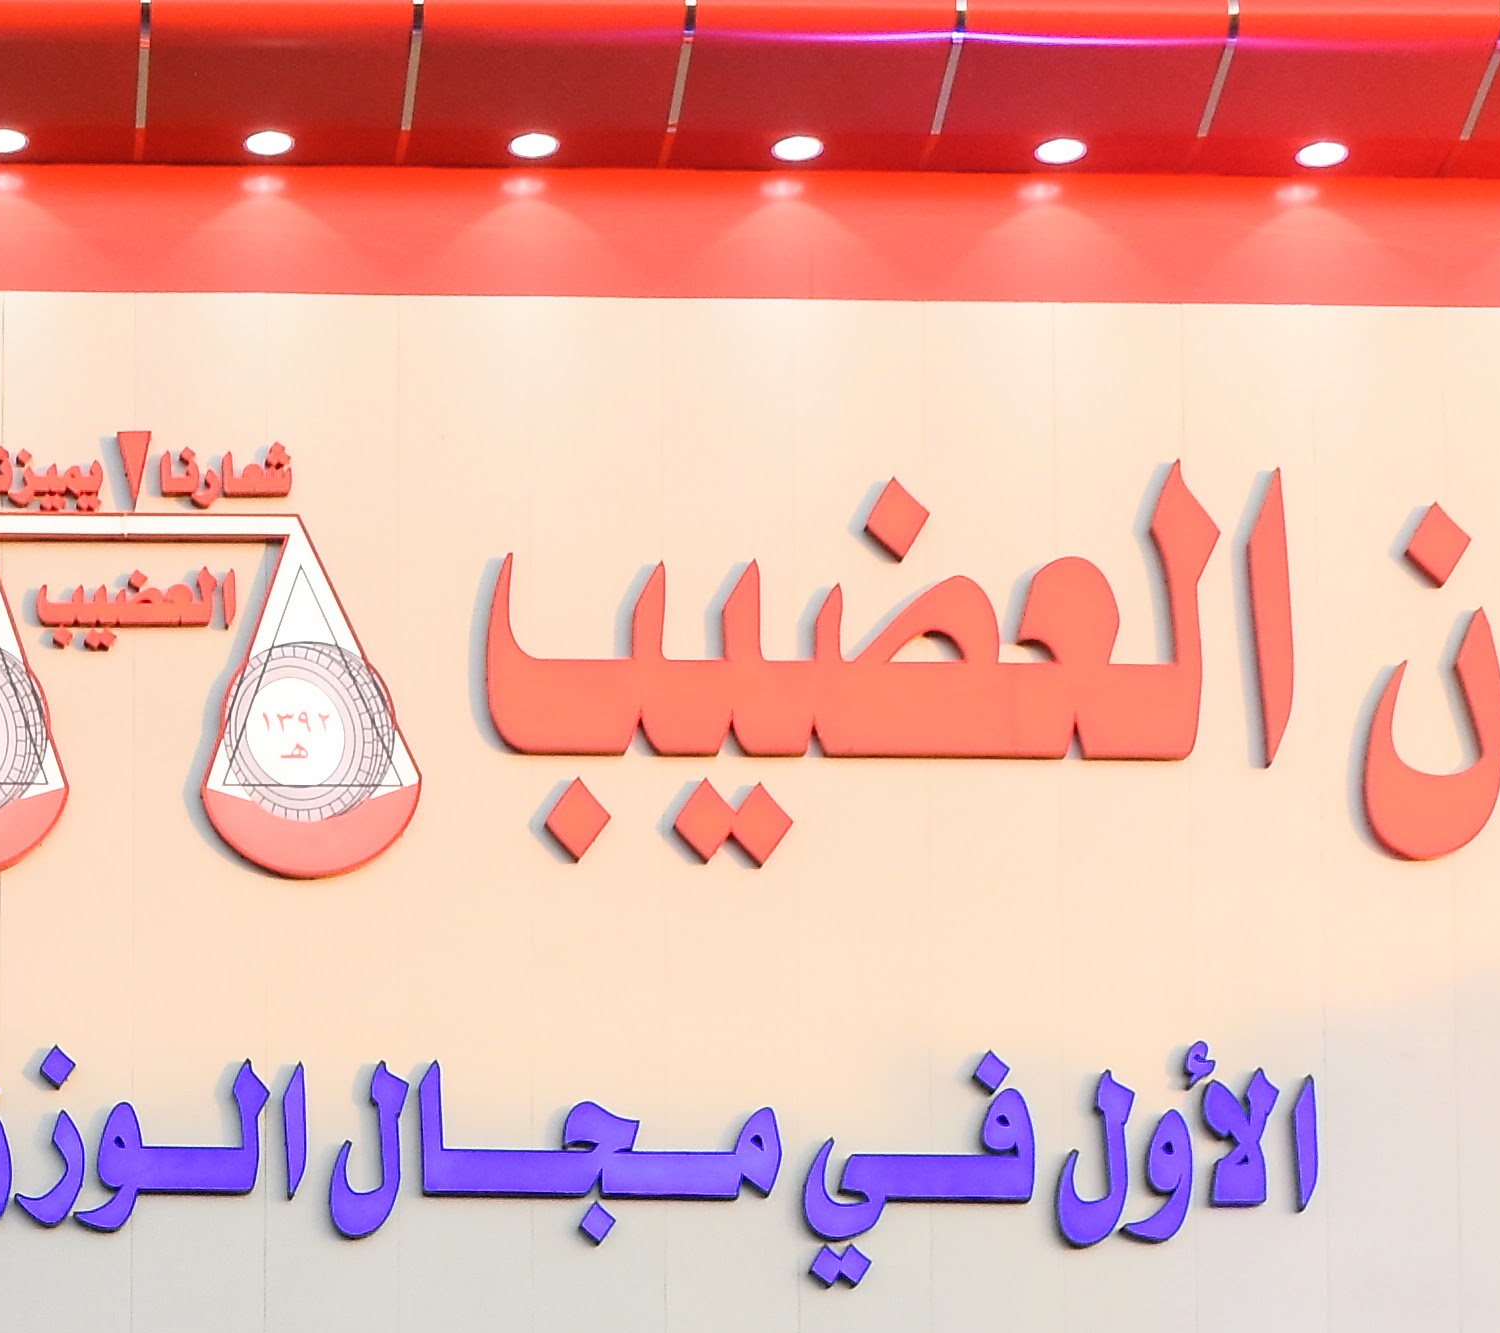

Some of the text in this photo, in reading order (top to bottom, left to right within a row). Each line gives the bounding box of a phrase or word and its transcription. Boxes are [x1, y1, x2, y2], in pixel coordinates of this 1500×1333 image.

[160, 441, 293, 508] شعارنا
[36, 567, 236, 651] العضيب
[486, 459, 1296, 867] العضيب
[262, 708, 331, 734] ١٣٩٢
[328, 1062, 783, 1245] مجال
[801, 1051, 1036, 1286] في
[1057, 1041, 1319, 1244] الأول
